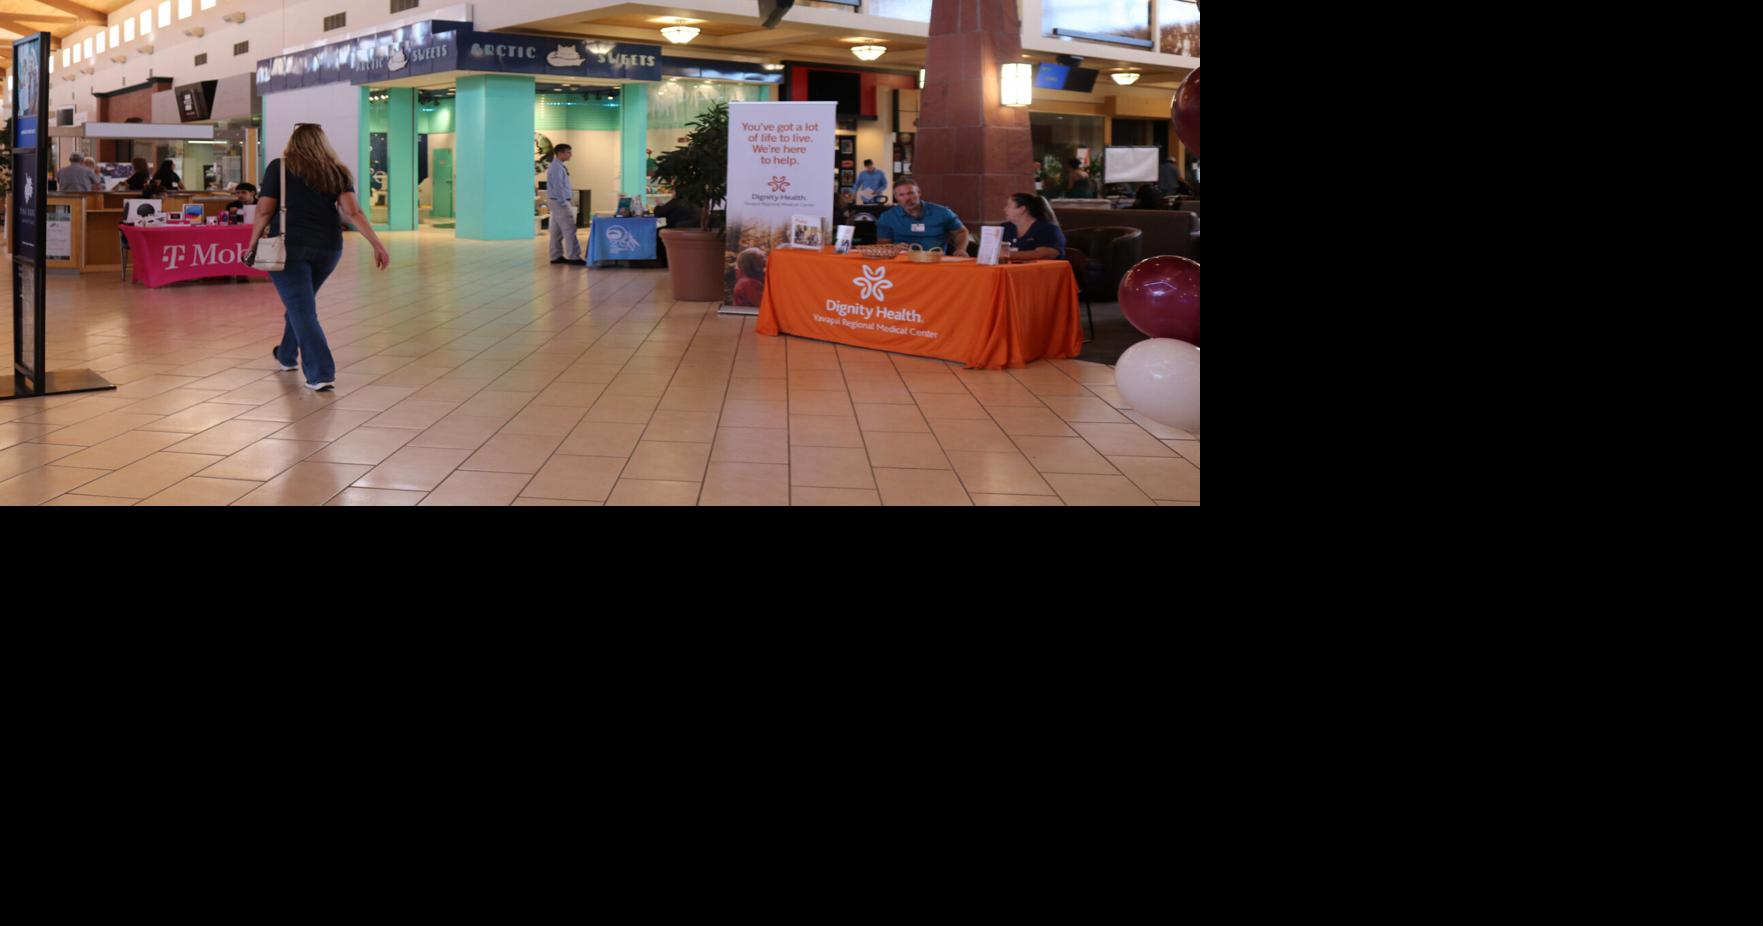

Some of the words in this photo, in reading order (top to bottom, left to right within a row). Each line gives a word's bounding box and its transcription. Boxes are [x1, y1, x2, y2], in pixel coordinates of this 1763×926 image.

[412, 44, 447, 62] SWEETS
[470, 43, 536, 59] ARCTIC
[597, 53, 655, 67] SWEETS
[742, 122, 775, 132] You've
[777, 123, 793, 133] got
[805, 123, 818, 131] lot
[748, 133, 758, 142] of
[761, 133, 777, 142] life
[779, 134, 790, 142] to
[793, 134, 814, 142] live.
[752, 145, 780, 153] We're
[783, 145, 806, 153] here
[761, 156, 771, 165] to
[773, 156, 800, 166] help.
[751, 193, 779, 202] Dignity
[825, 299, 874, 320] Dignity
[841, 318, 875, 330] Regional
[876, 324, 908, 335] Medical
[909, 328, 939, 338] Center
